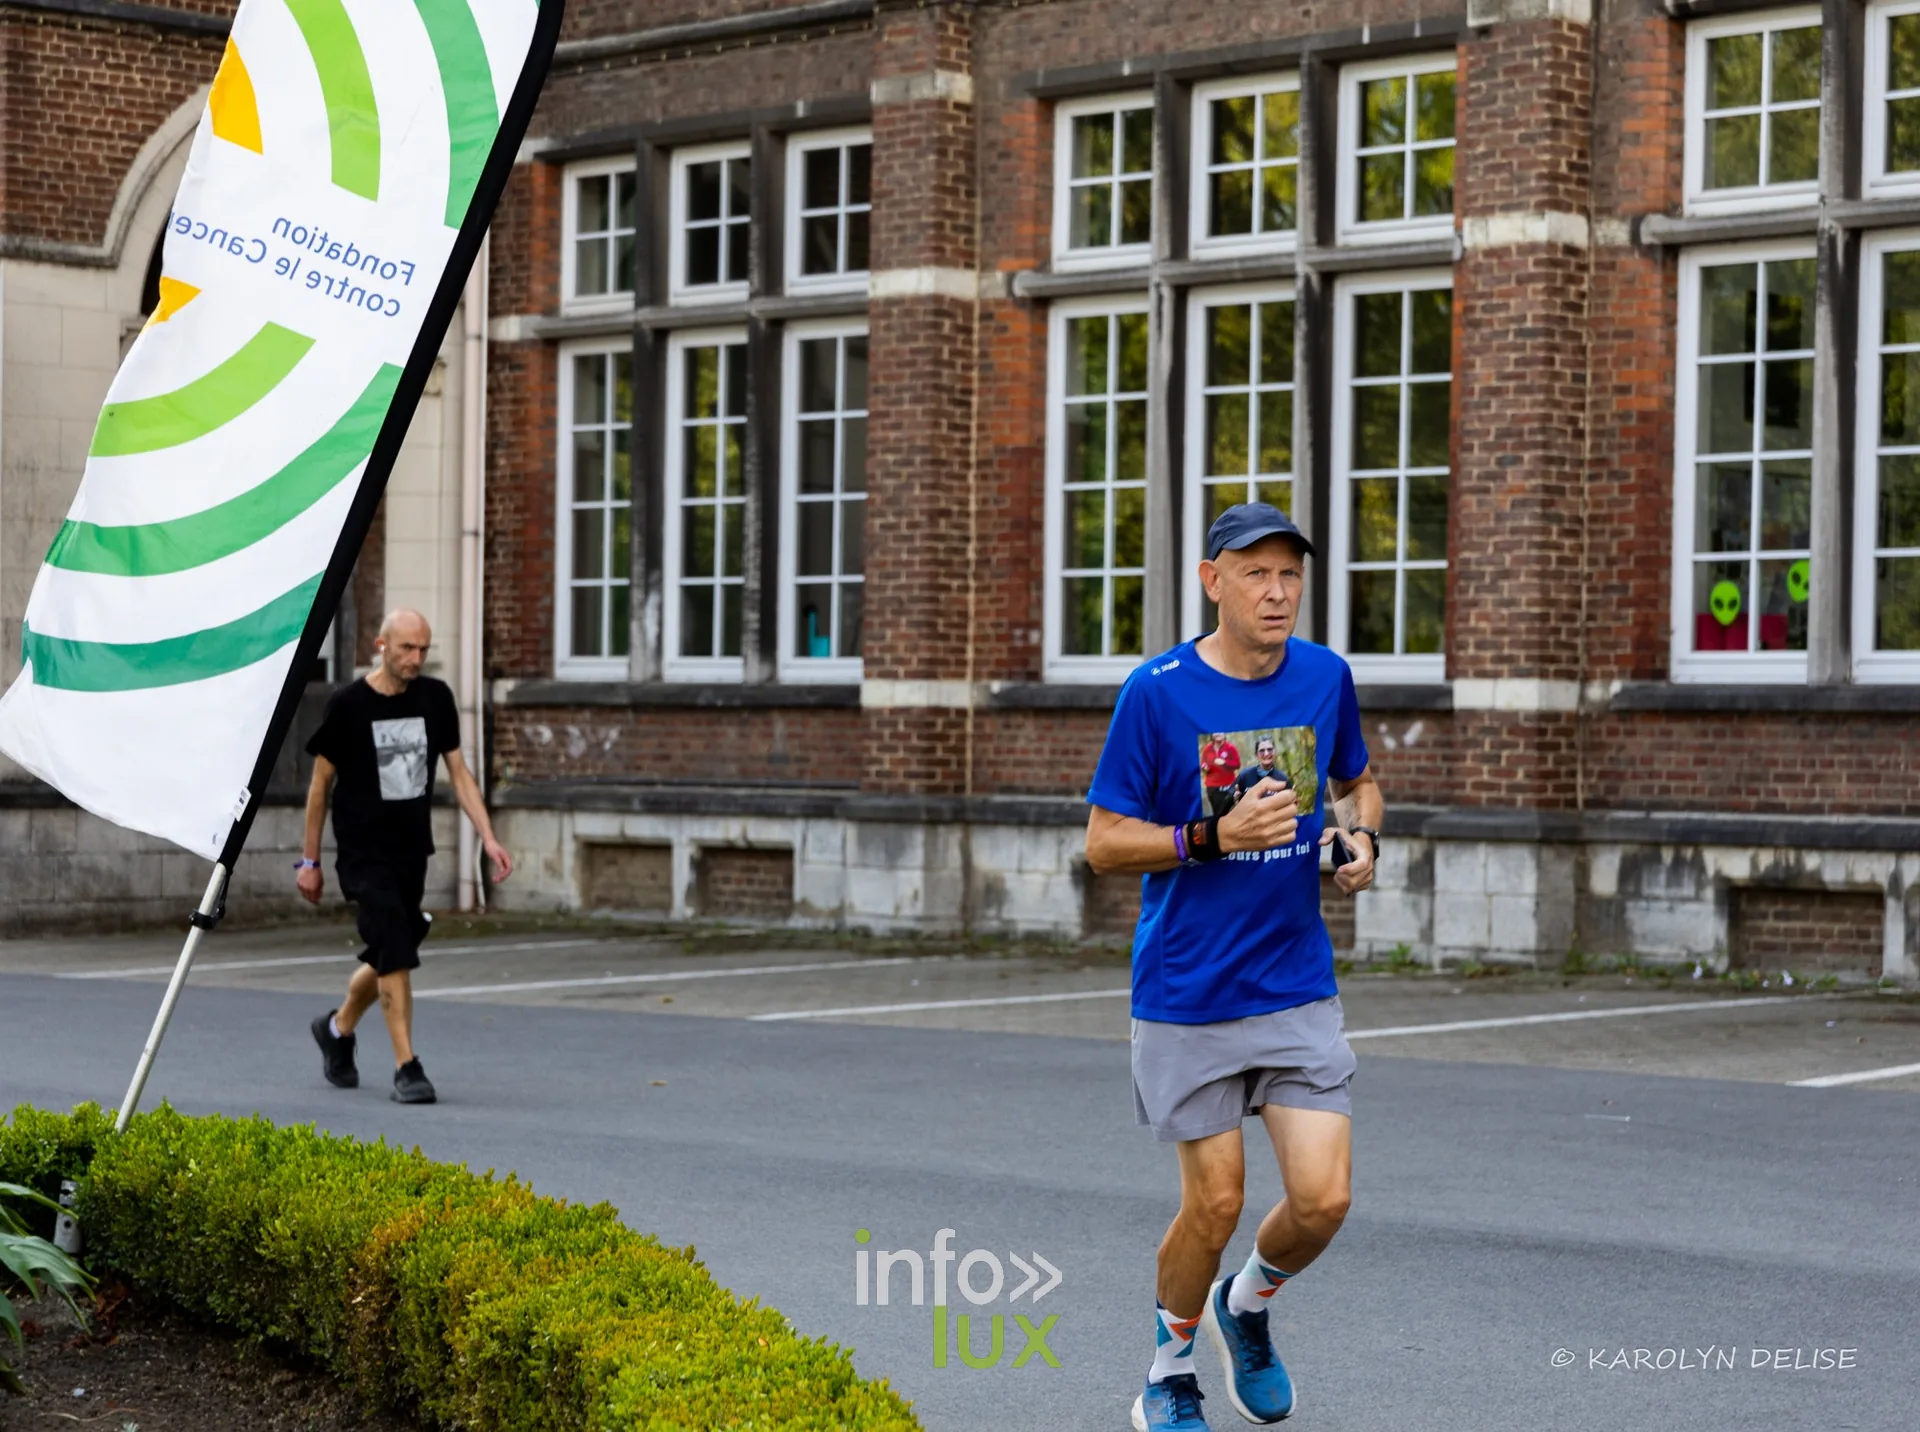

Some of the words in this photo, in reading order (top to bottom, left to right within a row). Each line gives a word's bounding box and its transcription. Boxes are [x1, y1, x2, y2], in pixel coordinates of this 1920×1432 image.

[1221, 851, 1261, 861] ours
[1263, 847, 1294, 864] pour
[1296, 840, 1310, 856] toi
